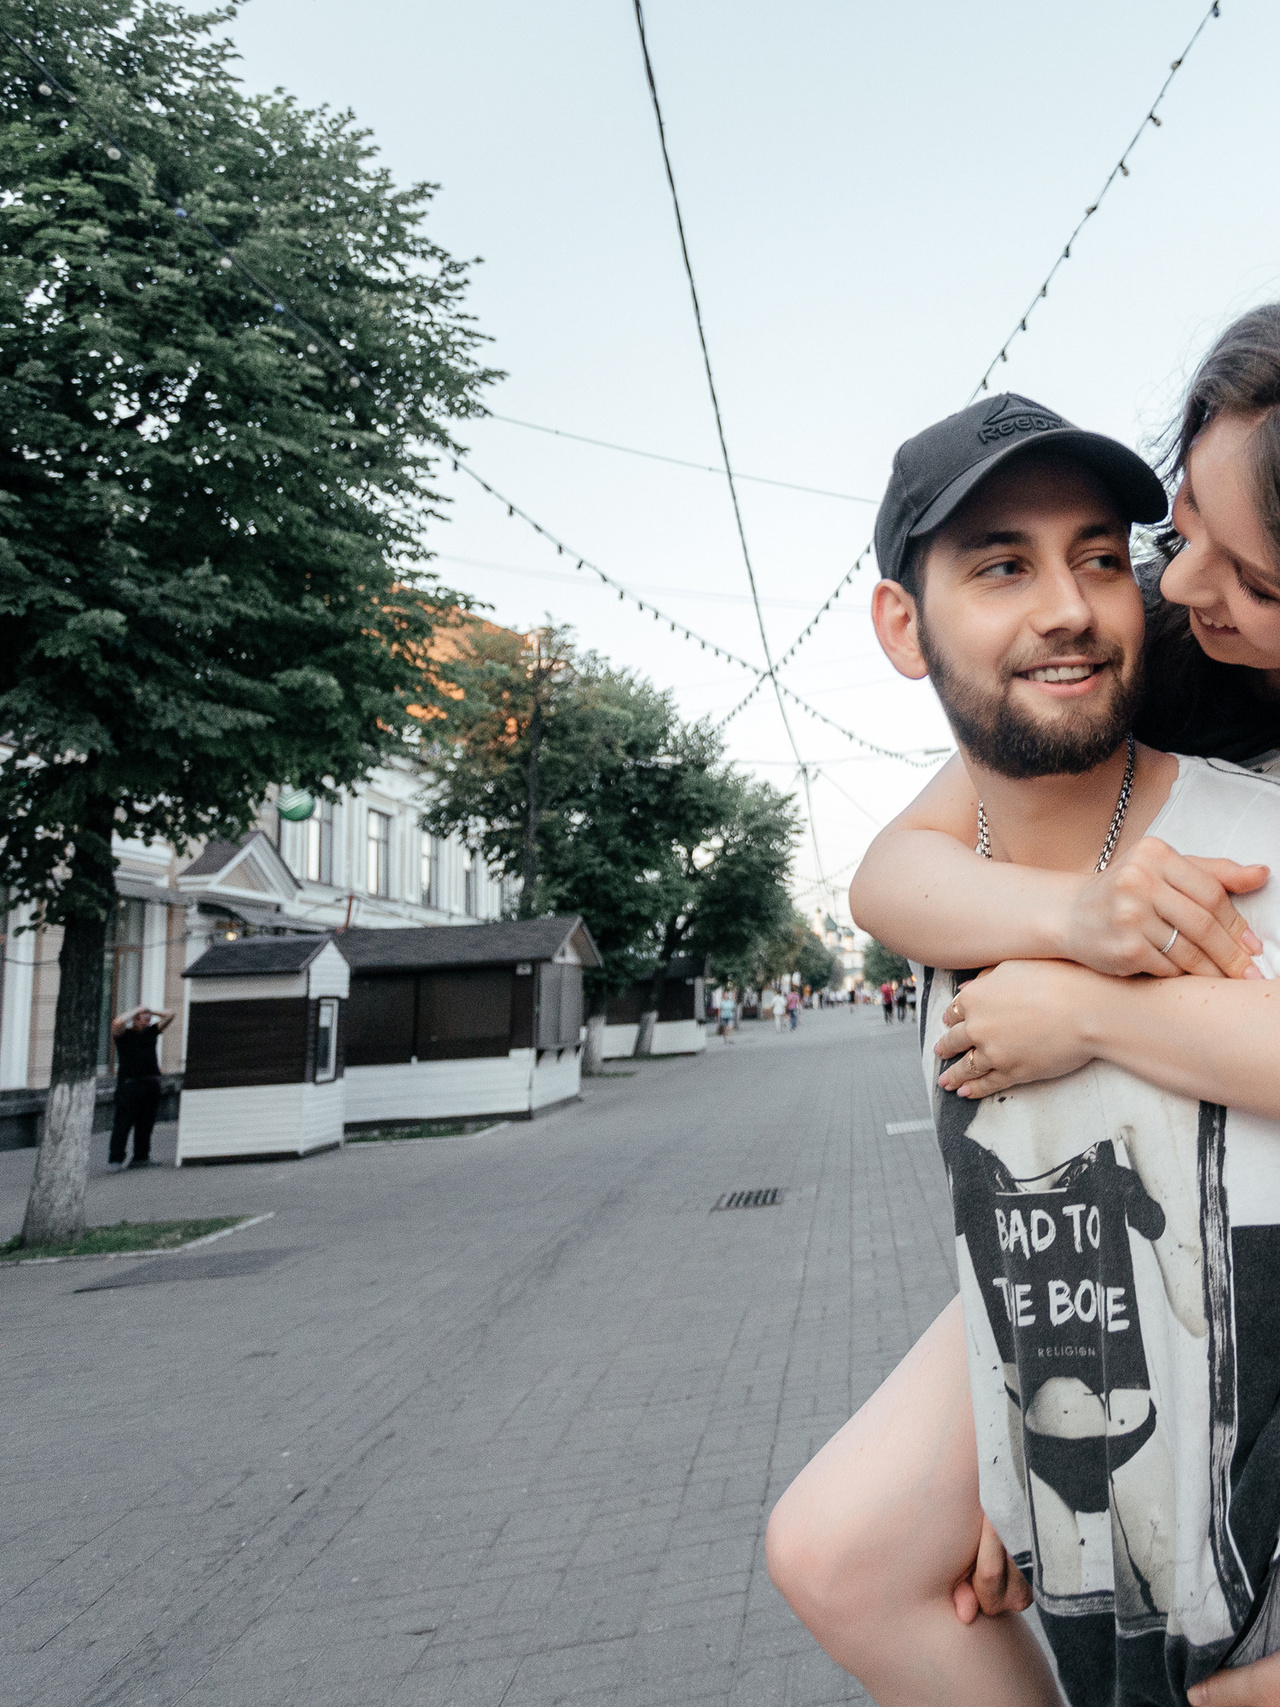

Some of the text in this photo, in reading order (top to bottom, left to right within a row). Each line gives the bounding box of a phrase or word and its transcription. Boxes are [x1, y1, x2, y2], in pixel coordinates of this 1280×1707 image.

[995, 1204, 1101, 1260] BAD TO
[992, 1277, 1036, 1327] TE
[1037, 1345, 1096, 1358] RELIGION
